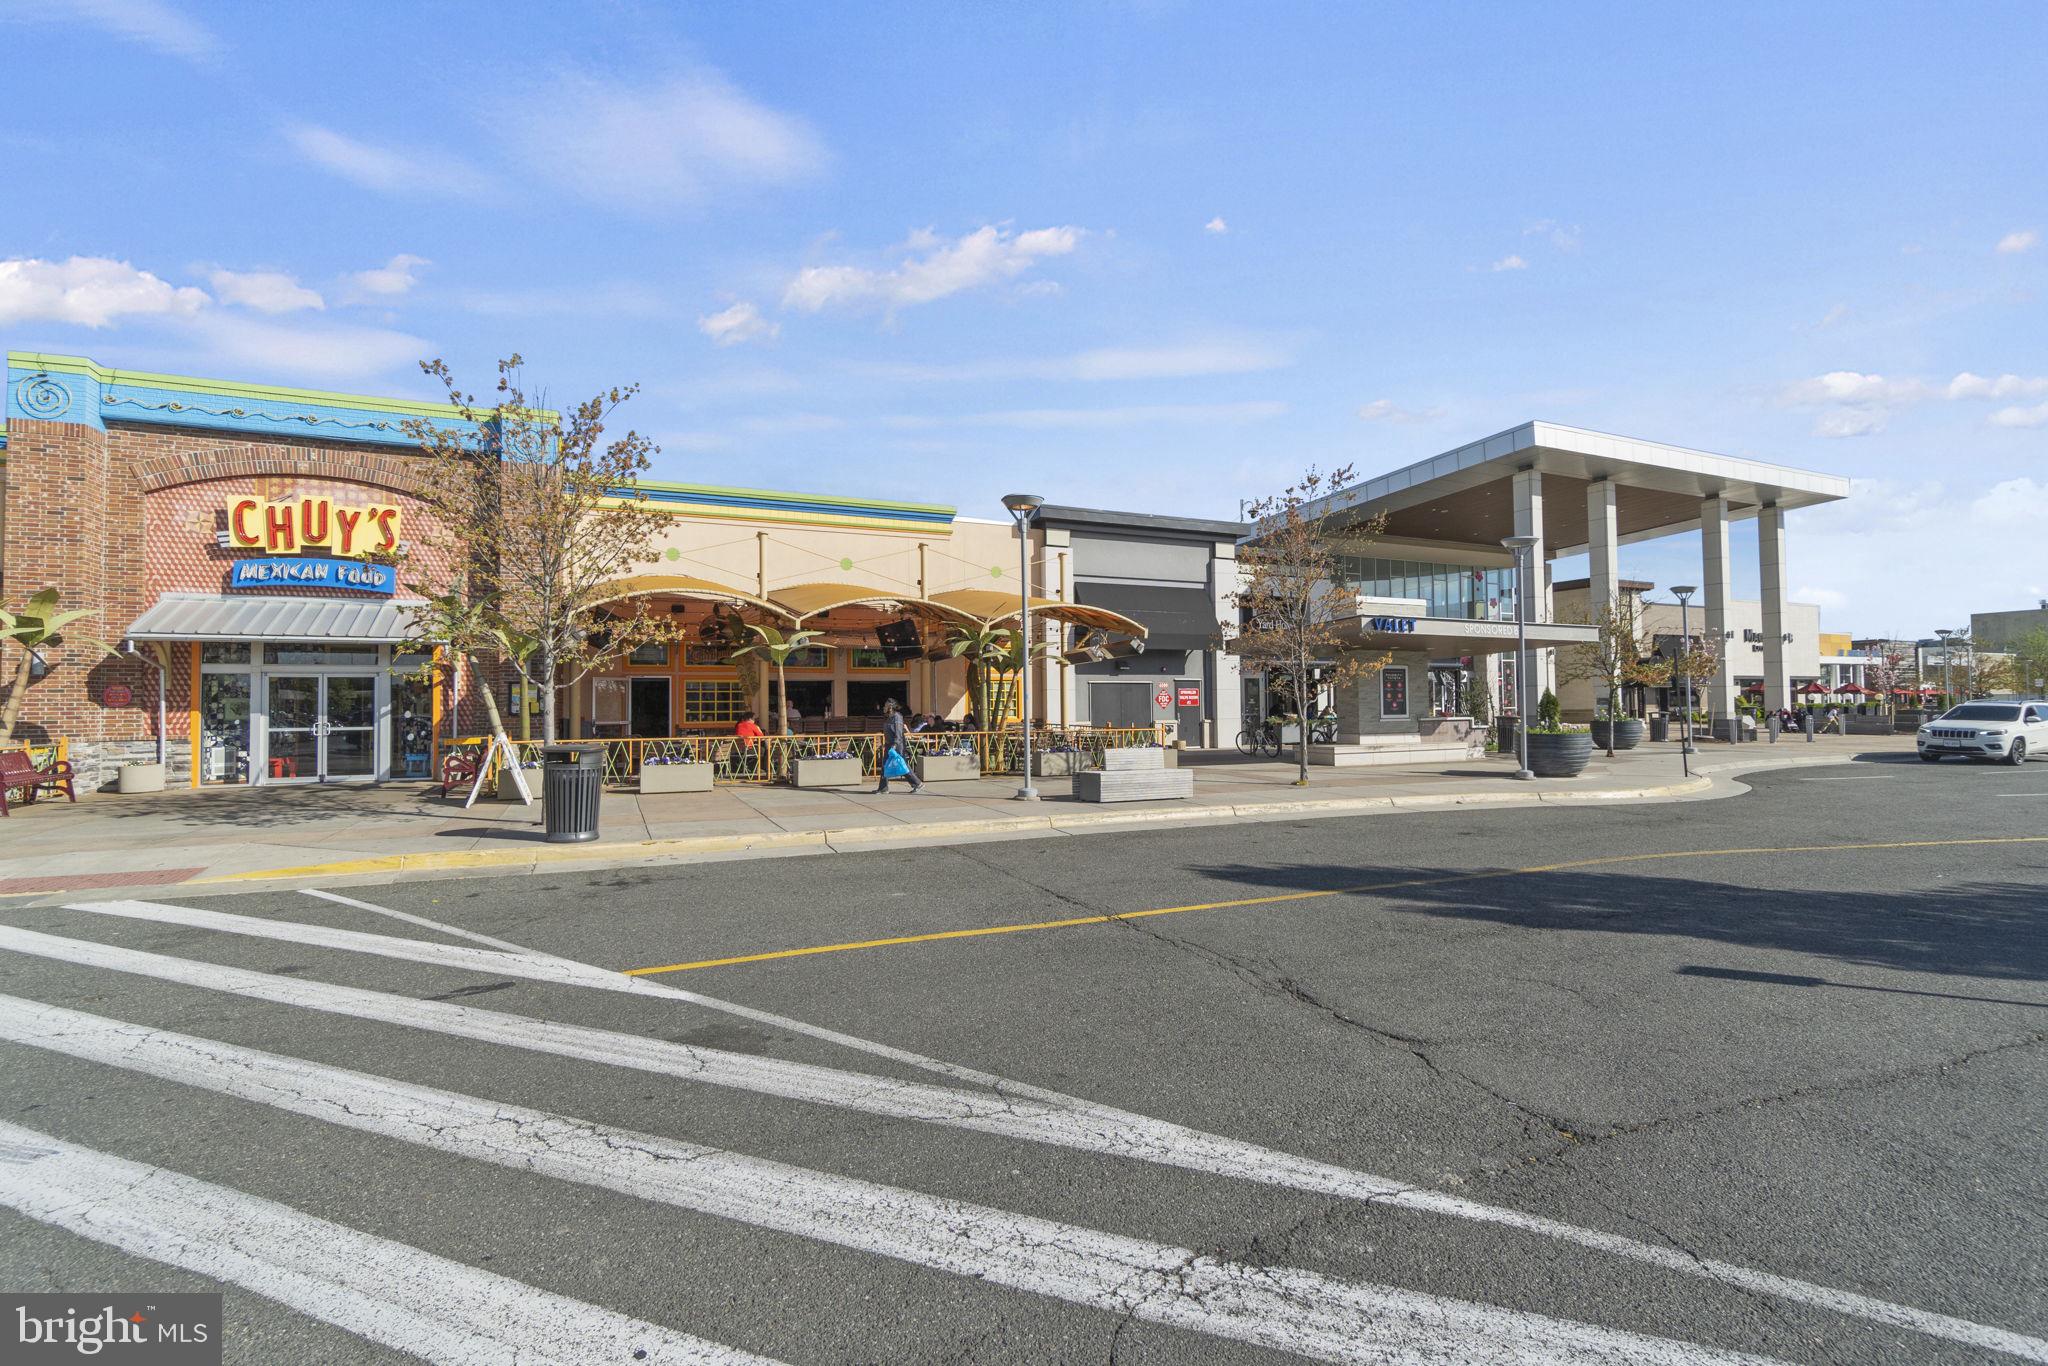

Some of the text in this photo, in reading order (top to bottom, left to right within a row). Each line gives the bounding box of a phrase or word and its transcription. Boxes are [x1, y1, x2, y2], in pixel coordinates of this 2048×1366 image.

[234, 499, 397, 554] CHUY'S
[239, 562, 387, 586] MEXICAN FOOD
[1373, 617, 1417, 633] VALET
[1464, 623, 1513, 636] SPONSORED
[1158, 695, 1170, 703] FDC
